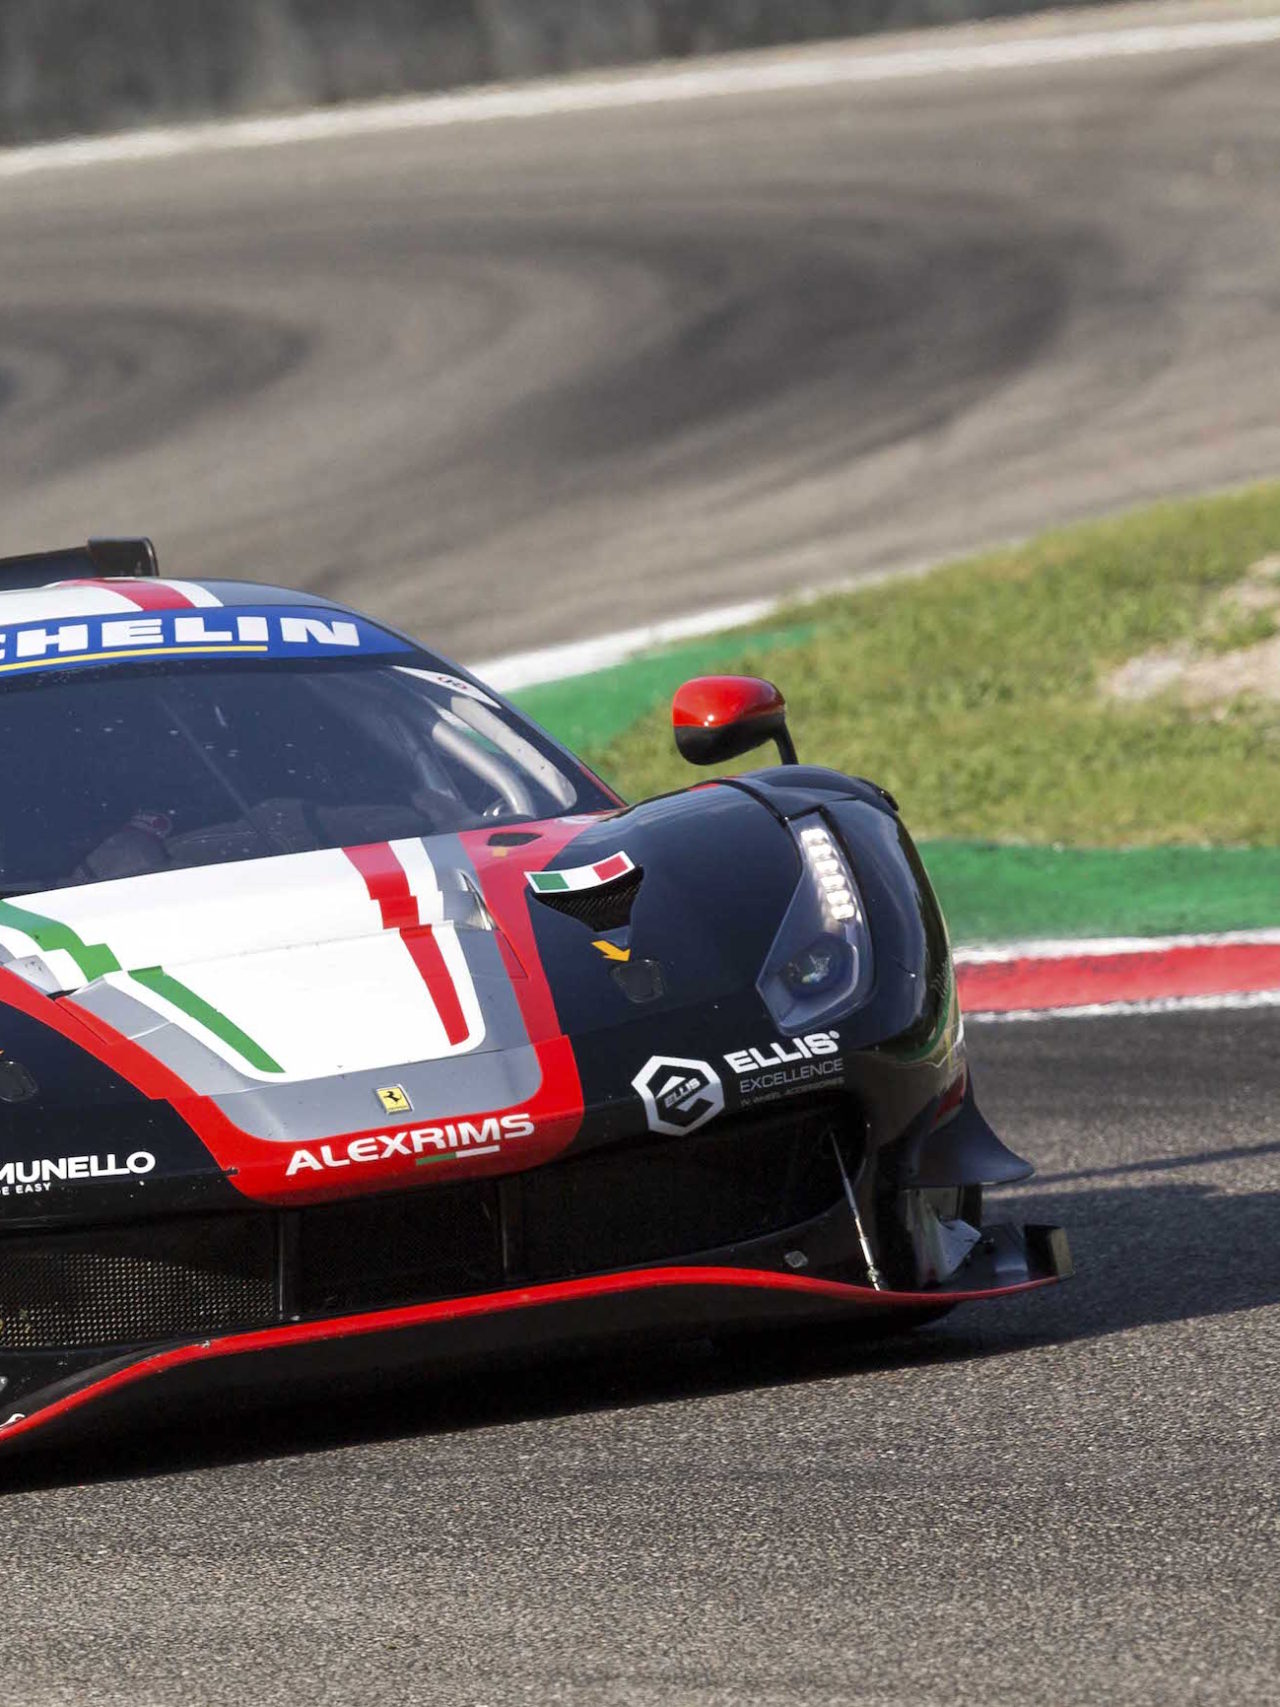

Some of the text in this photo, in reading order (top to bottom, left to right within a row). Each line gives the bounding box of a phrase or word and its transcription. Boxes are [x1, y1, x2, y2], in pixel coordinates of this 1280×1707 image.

[739, 1058, 845, 1094] EXCELLENCE
[285, 1113, 535, 1176] ALEXRIMS
[16, 1182, 52, 1195] EASY
